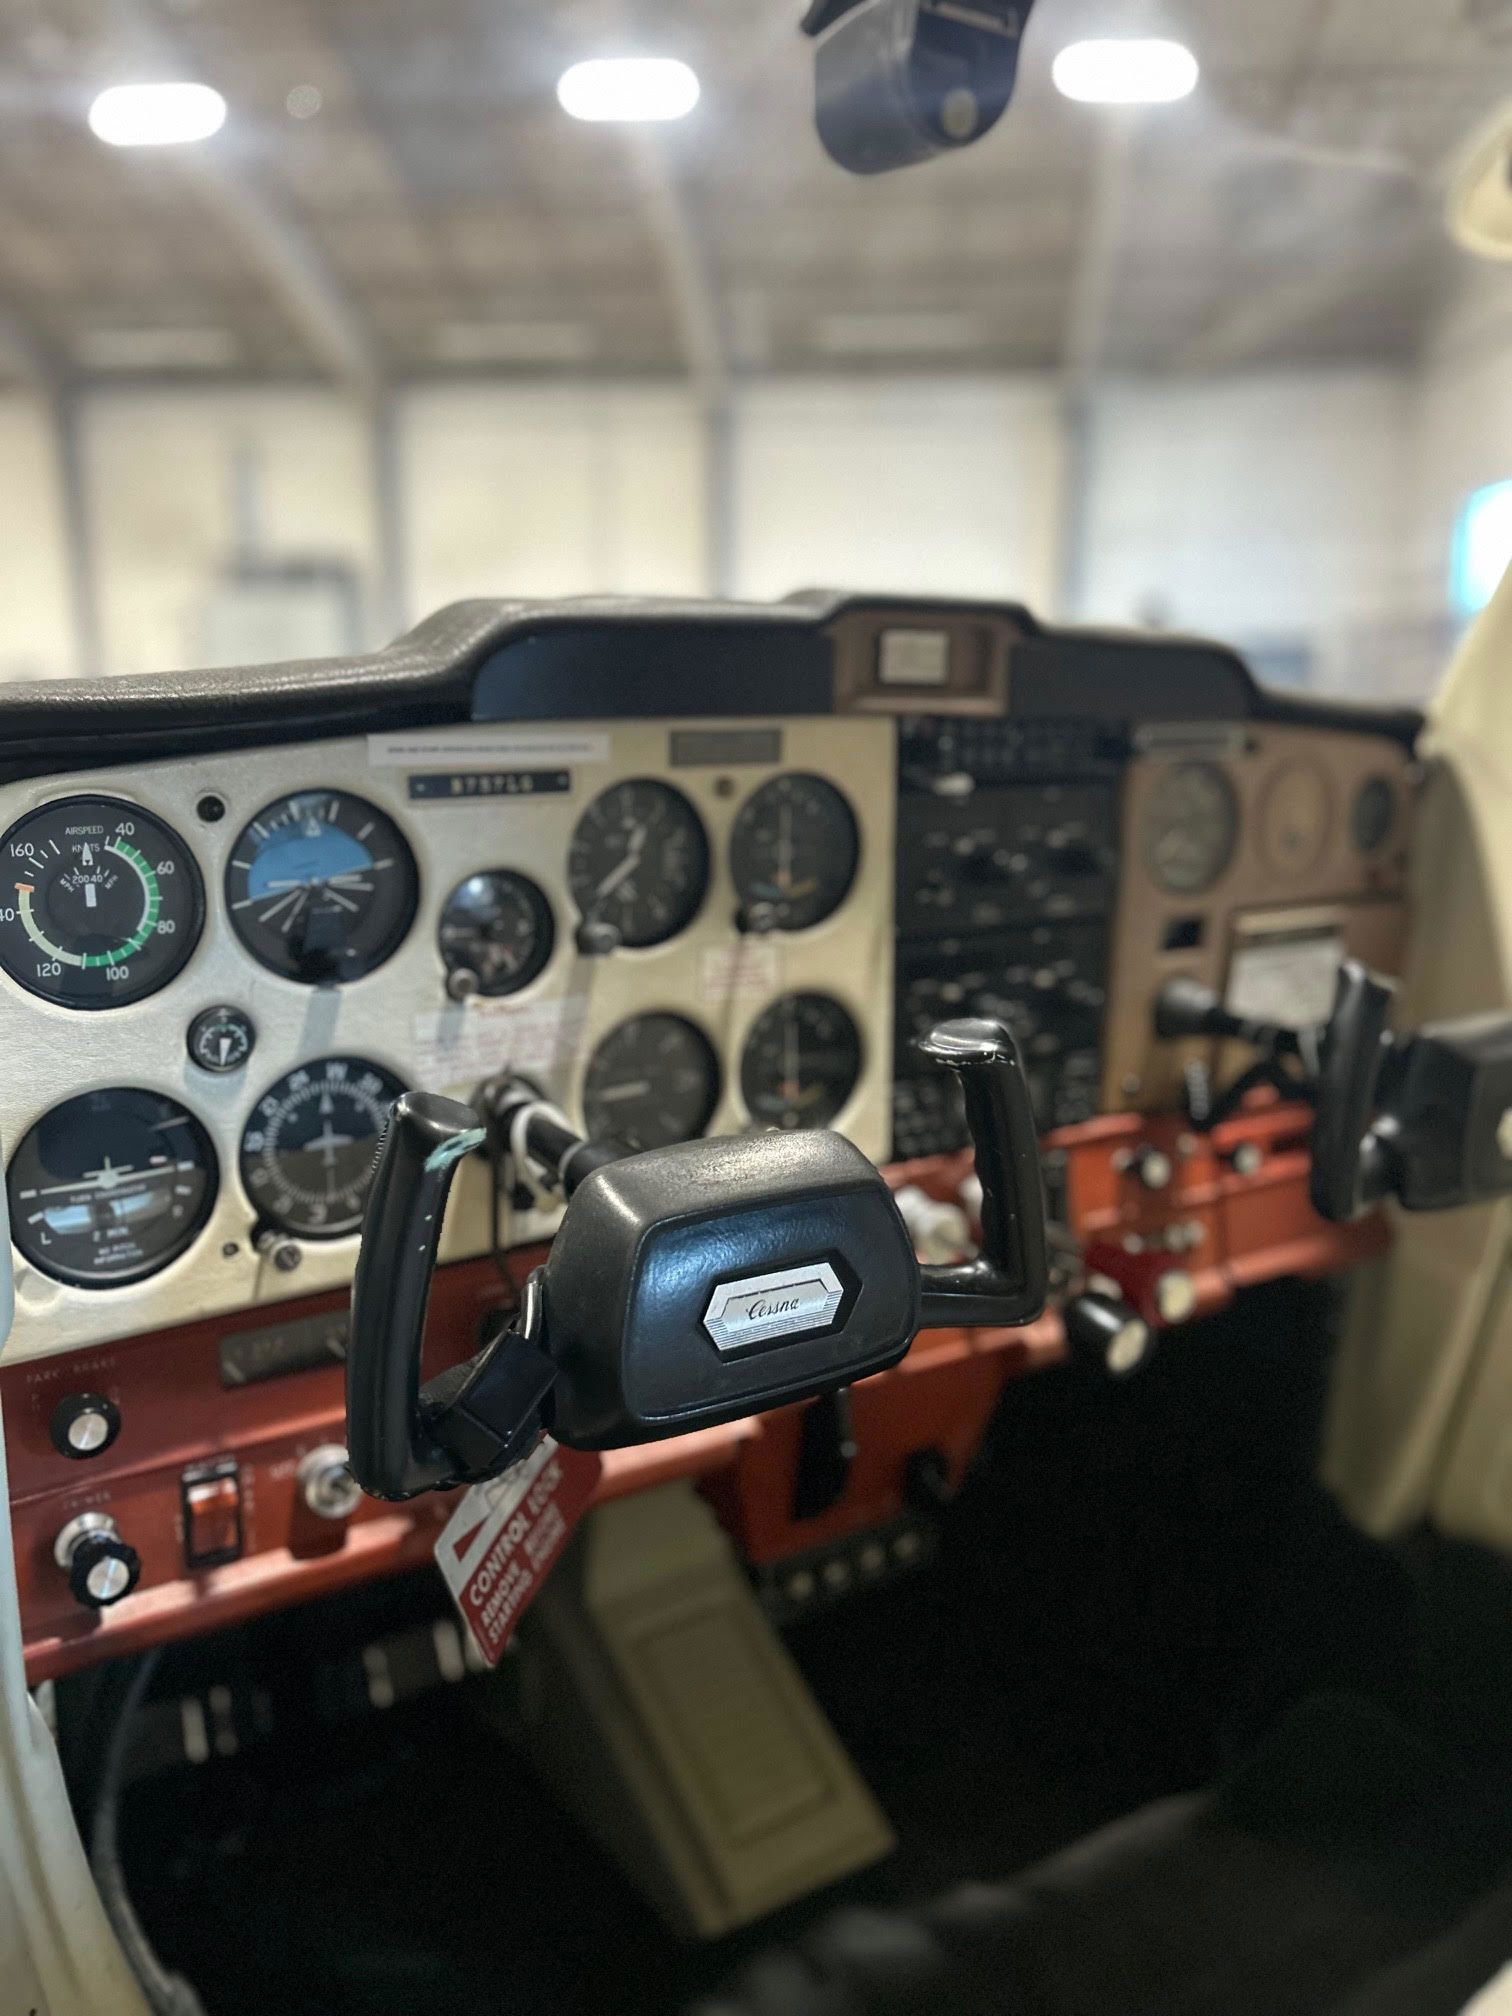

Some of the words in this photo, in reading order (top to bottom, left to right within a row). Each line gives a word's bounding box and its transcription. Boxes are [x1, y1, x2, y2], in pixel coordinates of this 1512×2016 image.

[65, 825, 104, 836] AIRSPEED
[115, 822, 135, 836] 40
[10, 843, 34, 858] 160
[71, 843, 100, 853] KNTS
[156, 860, 175, 875] 60
[72, 874, 90, 885] 200
[90, 874, 103, 884] 40
[156, 920, 176, 935] 80
[36, 962, 62, 978] 120
[105, 965, 130, 980] 100
[40, 1231, 52, 1246] L
[746, 1297, 800, 1320] Cessna
[469, 1510, 532, 1607] CONTROL
